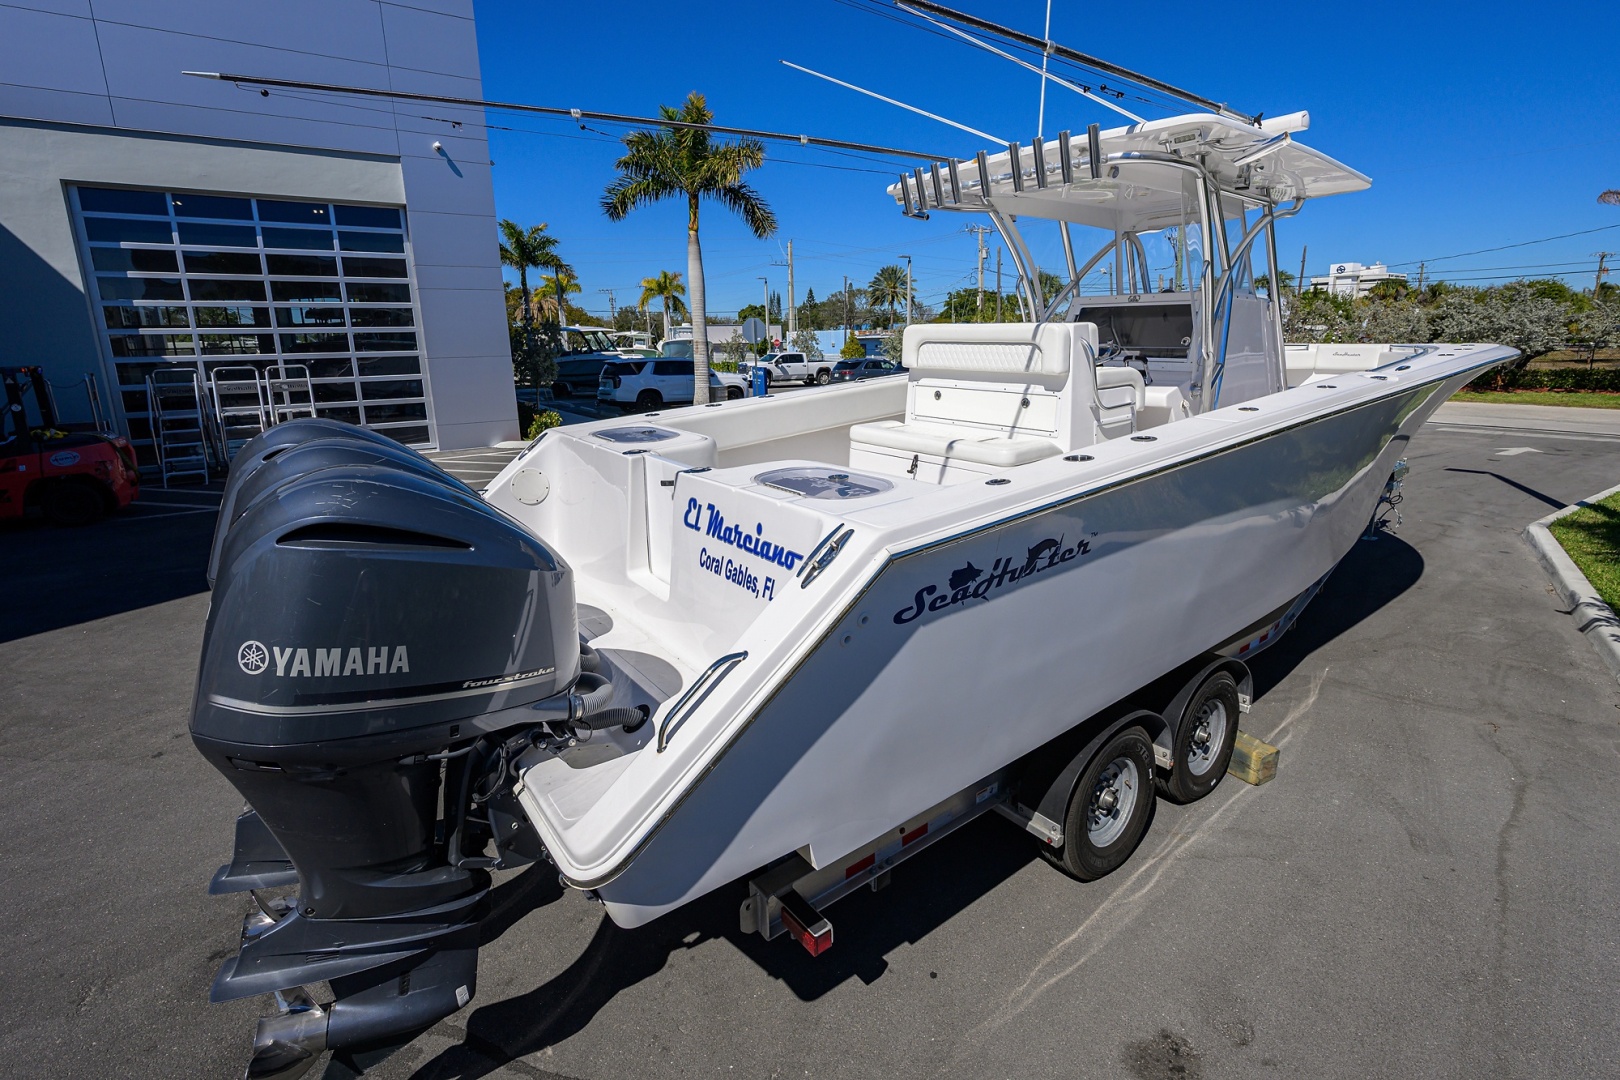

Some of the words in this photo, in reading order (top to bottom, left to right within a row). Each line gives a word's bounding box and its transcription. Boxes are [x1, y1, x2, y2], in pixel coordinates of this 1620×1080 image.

[684, 497, 702, 532] El
[706, 503, 804, 570] Marciano
[700, 547, 724, 576] Coral
[725, 559, 760, 599] Gables,
[272, 645, 410, 678] YAMAHA
